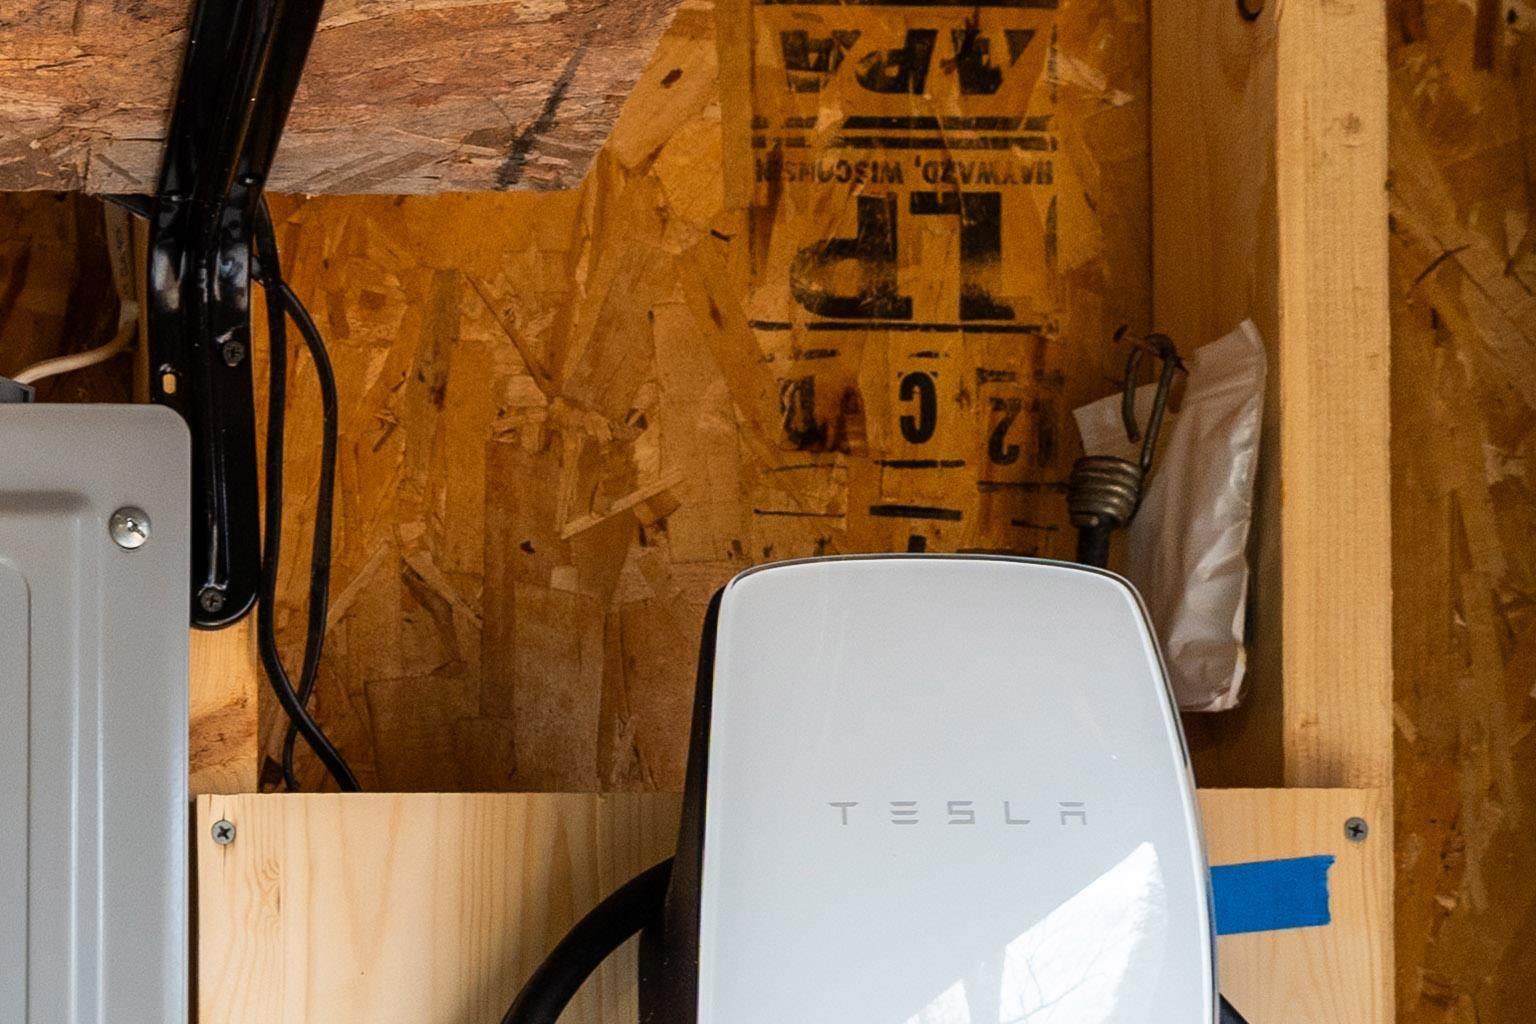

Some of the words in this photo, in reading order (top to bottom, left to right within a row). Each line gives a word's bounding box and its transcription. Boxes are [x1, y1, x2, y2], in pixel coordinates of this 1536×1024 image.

[788, 190, 1016, 321] LP
[898, 371, 938, 444] C
[829, 800, 1088, 826] TESLA
